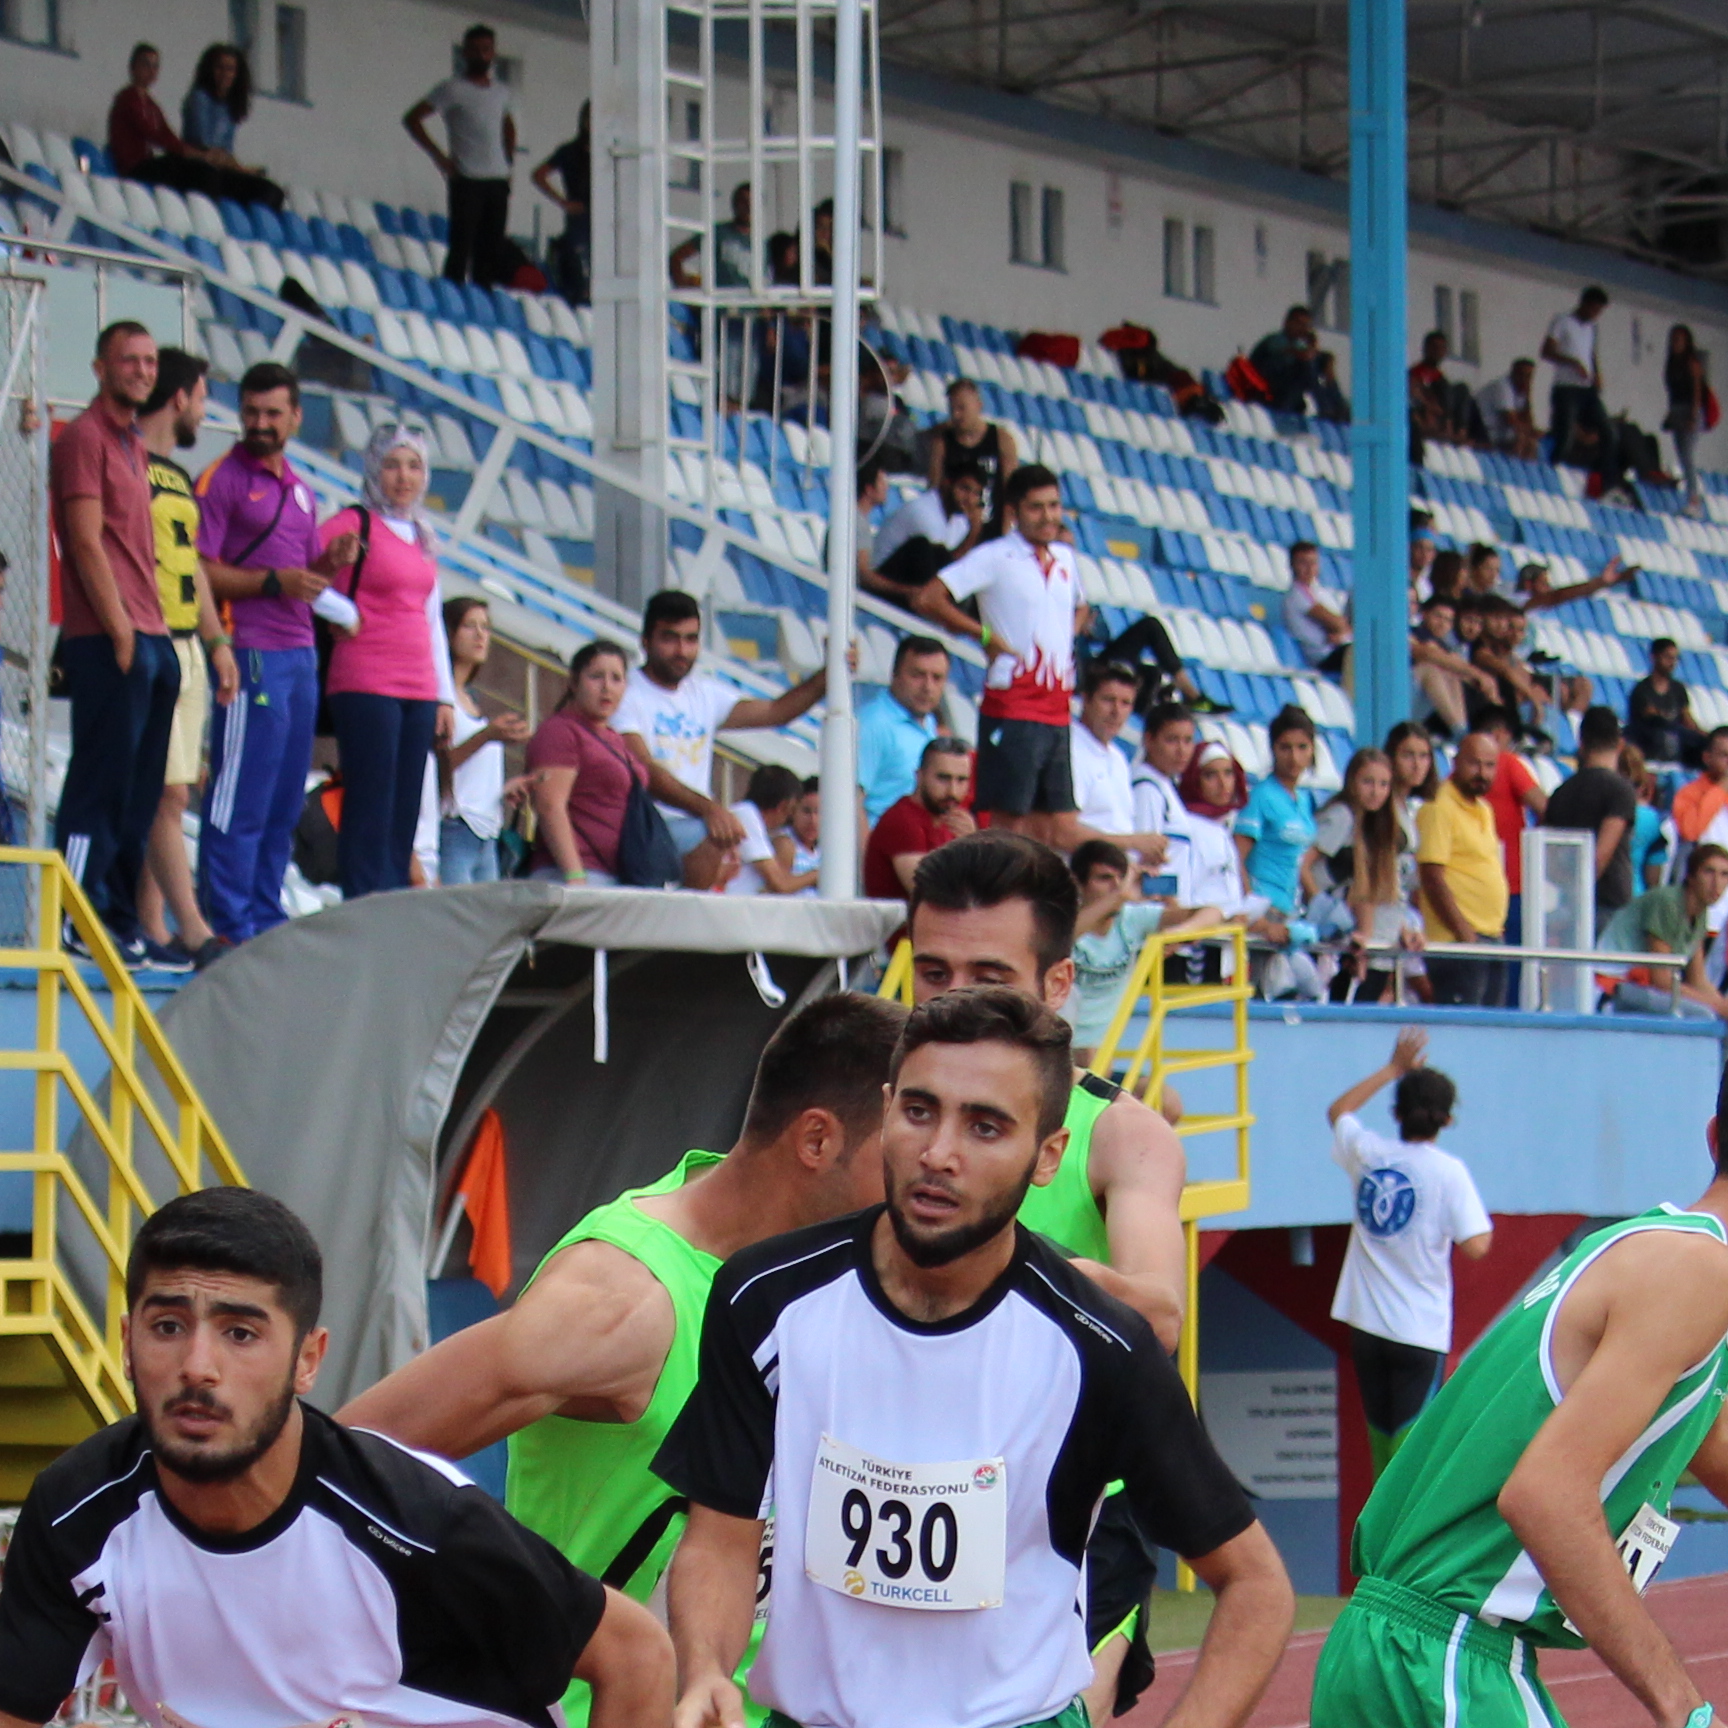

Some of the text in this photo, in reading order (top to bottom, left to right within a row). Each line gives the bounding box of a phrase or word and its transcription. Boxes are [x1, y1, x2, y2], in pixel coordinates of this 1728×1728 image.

[818, 1456, 970, 1496] ATLETİZM FEDERASYONU
[860, 1458, 913, 1481] TÜRKİYE
[840, 1487, 959, 1583] 930
[870, 1581, 953, 1603] TURKCELL
